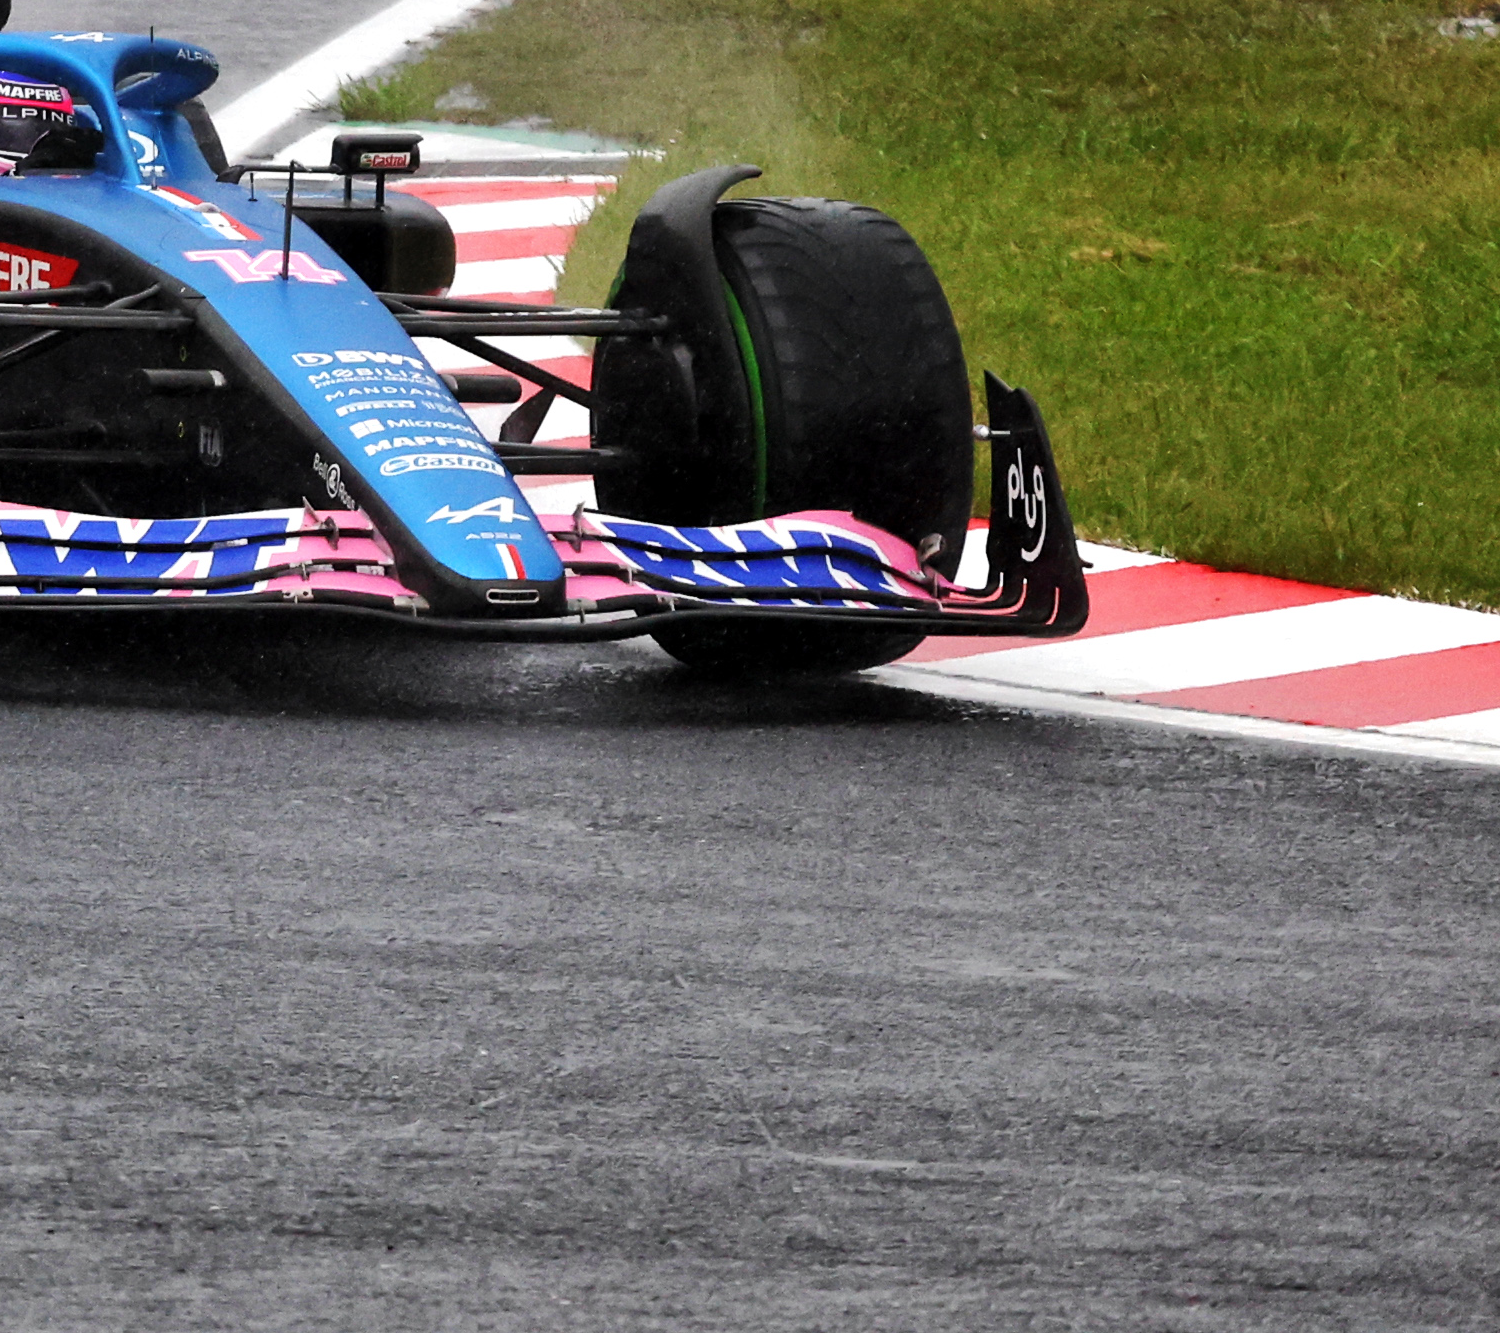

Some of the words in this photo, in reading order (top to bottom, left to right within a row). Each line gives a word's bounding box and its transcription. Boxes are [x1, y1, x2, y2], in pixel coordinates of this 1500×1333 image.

[183, 248, 348, 284] 14
[334, 350, 425, 370] BWT
[1007, 447, 1047, 563] plug
[601, 521, 902, 610] BWT
